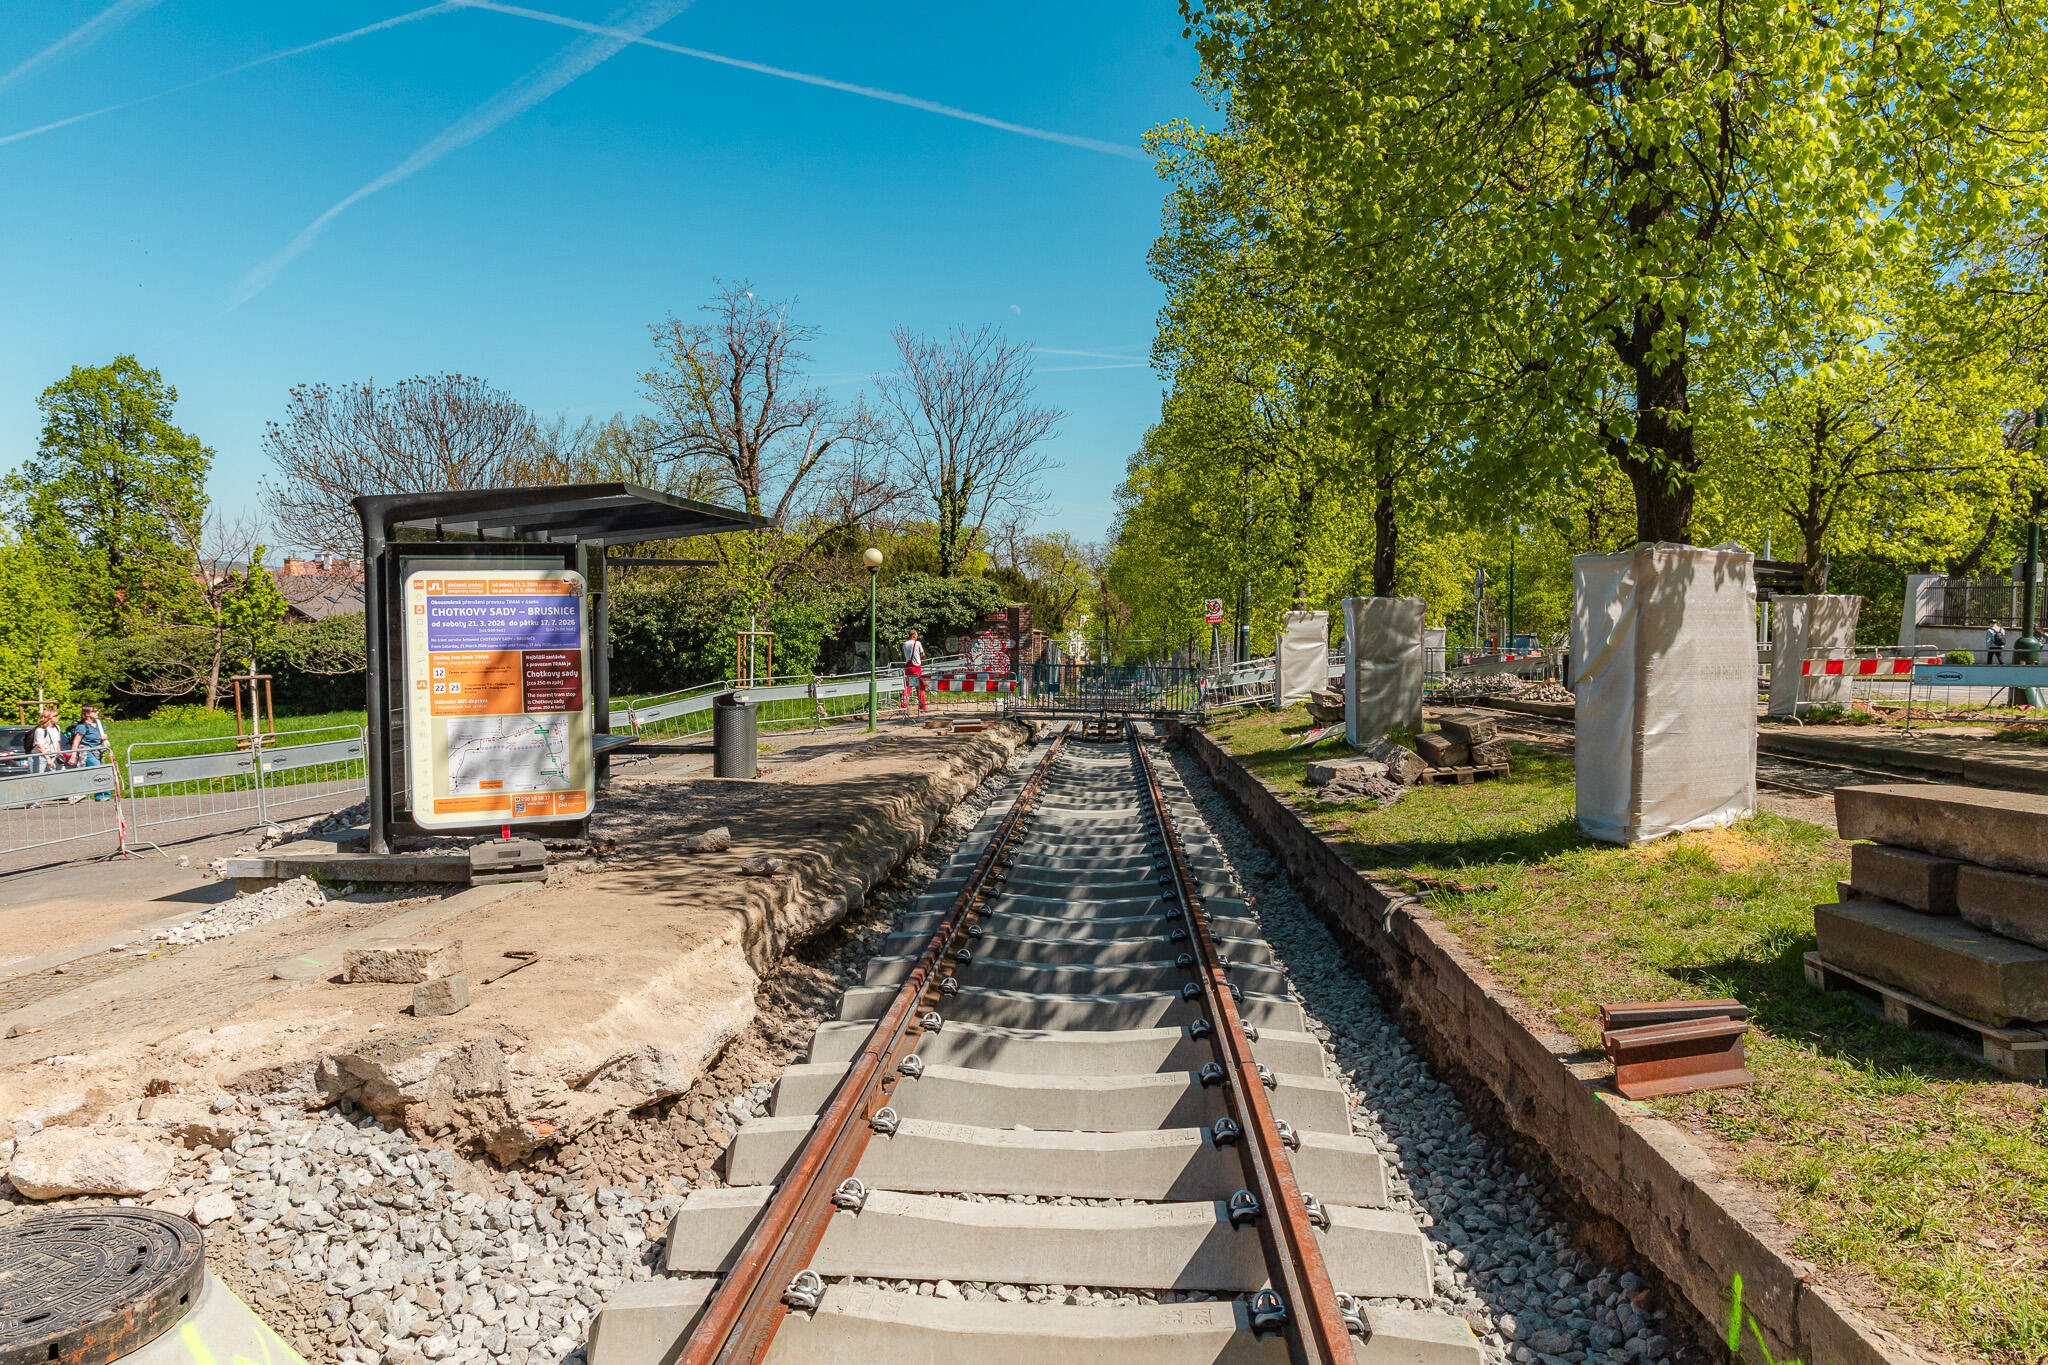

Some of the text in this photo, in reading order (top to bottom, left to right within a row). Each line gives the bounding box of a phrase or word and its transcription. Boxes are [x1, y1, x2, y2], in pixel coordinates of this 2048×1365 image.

[432, 607, 487, 616] CHOTKOVY
[489, 607, 516, 616] SADY
[528, 607, 575, 615] BRUSNICE
[442, 620, 467, 628] soboty
[520, 619, 539, 627] pátku
[435, 669, 444, 677] 12
[526, 669, 578, 678] Chotkovy sady
